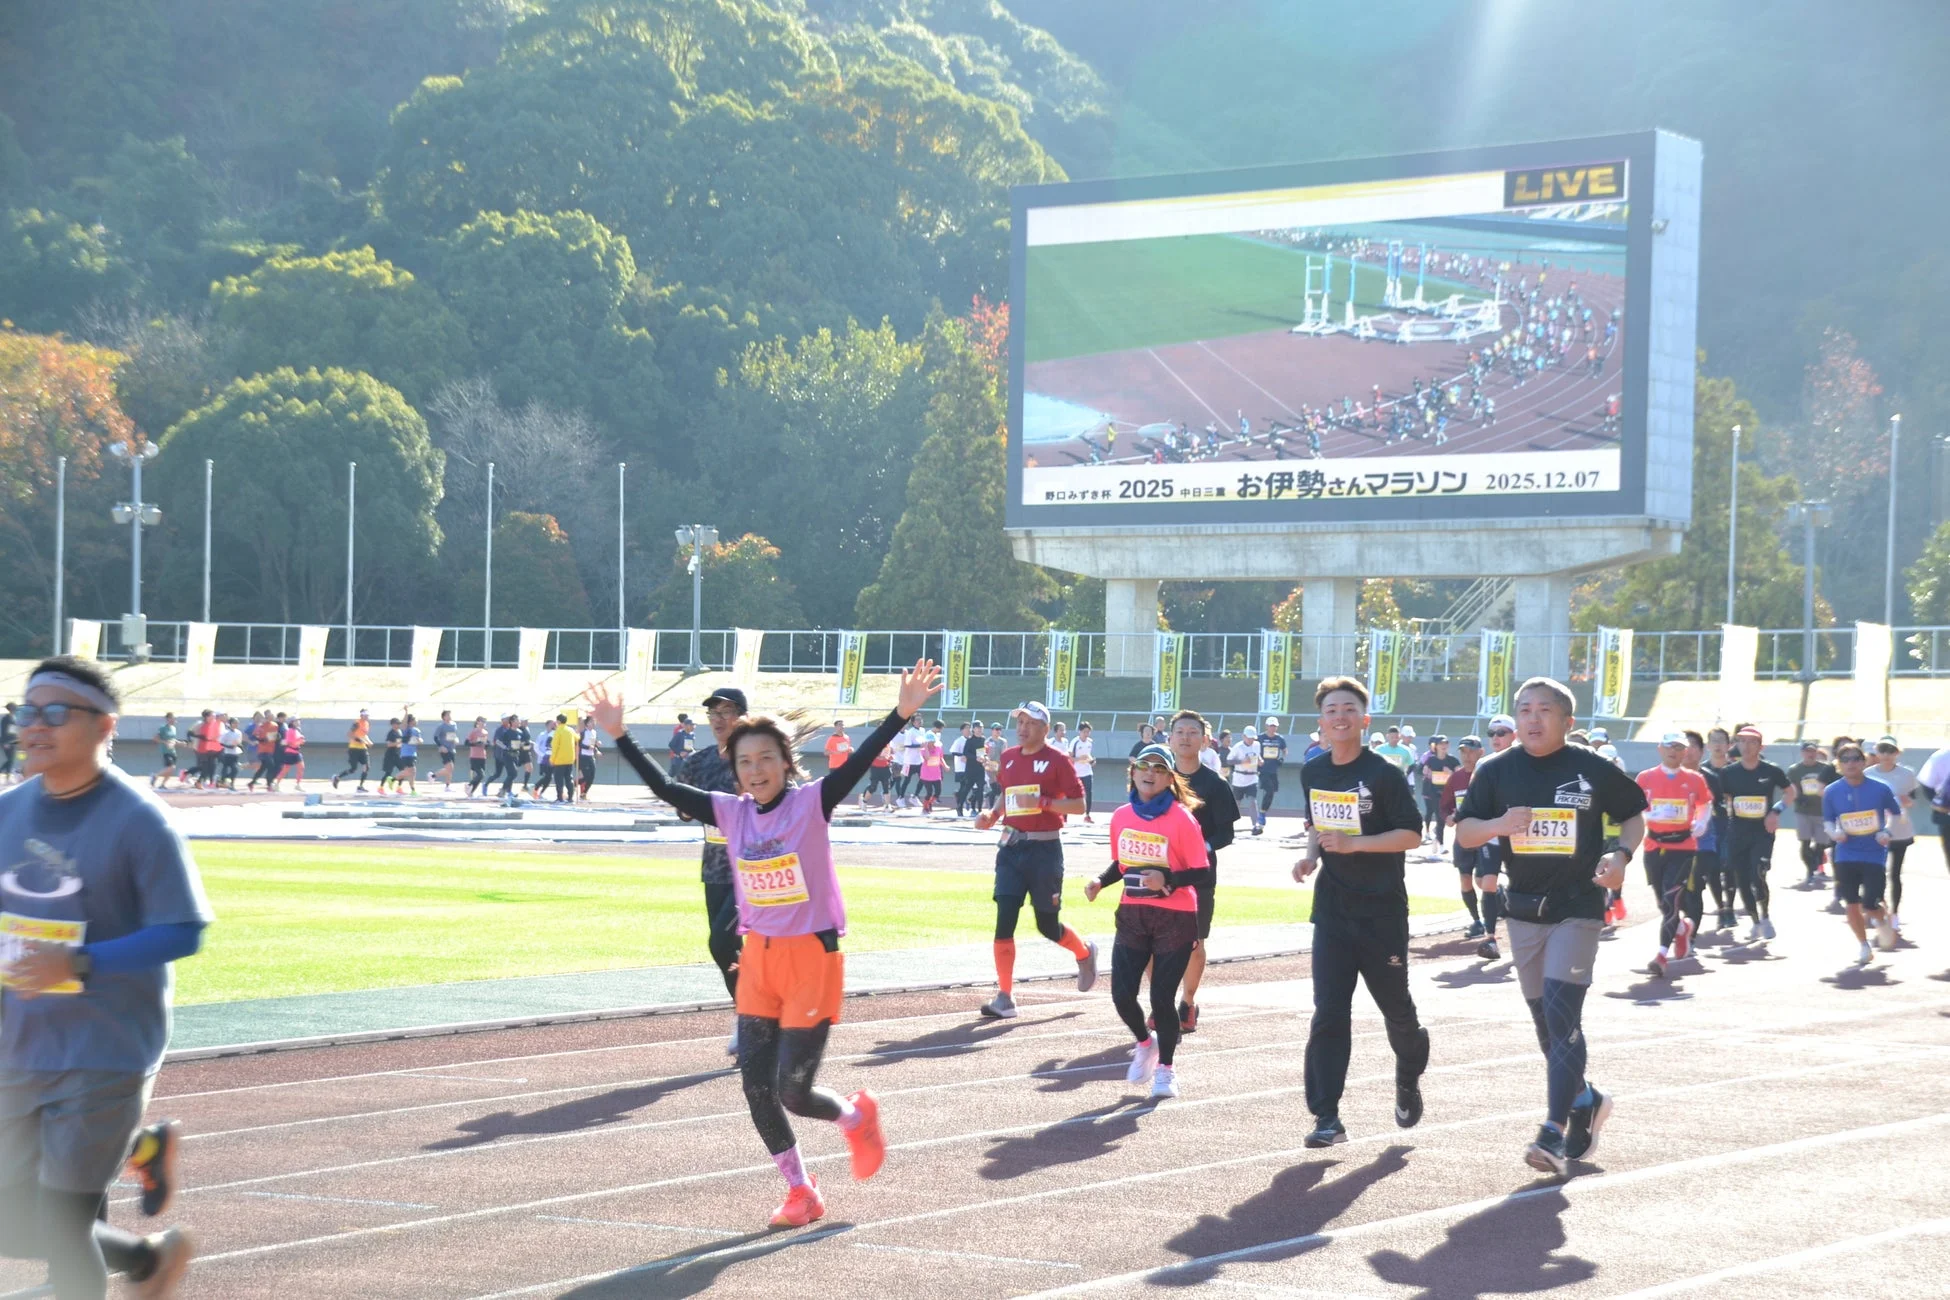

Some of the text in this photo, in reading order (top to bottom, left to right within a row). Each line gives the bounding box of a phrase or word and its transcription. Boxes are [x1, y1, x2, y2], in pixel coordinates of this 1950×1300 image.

[1513, 167, 1617, 202] LIVE
[1045, 470, 1600, 501] 野口みずき杯 2025 中日三重 お伊勢さんマラソン 2025.12.07
[1033, 760, 1049, 773] W
